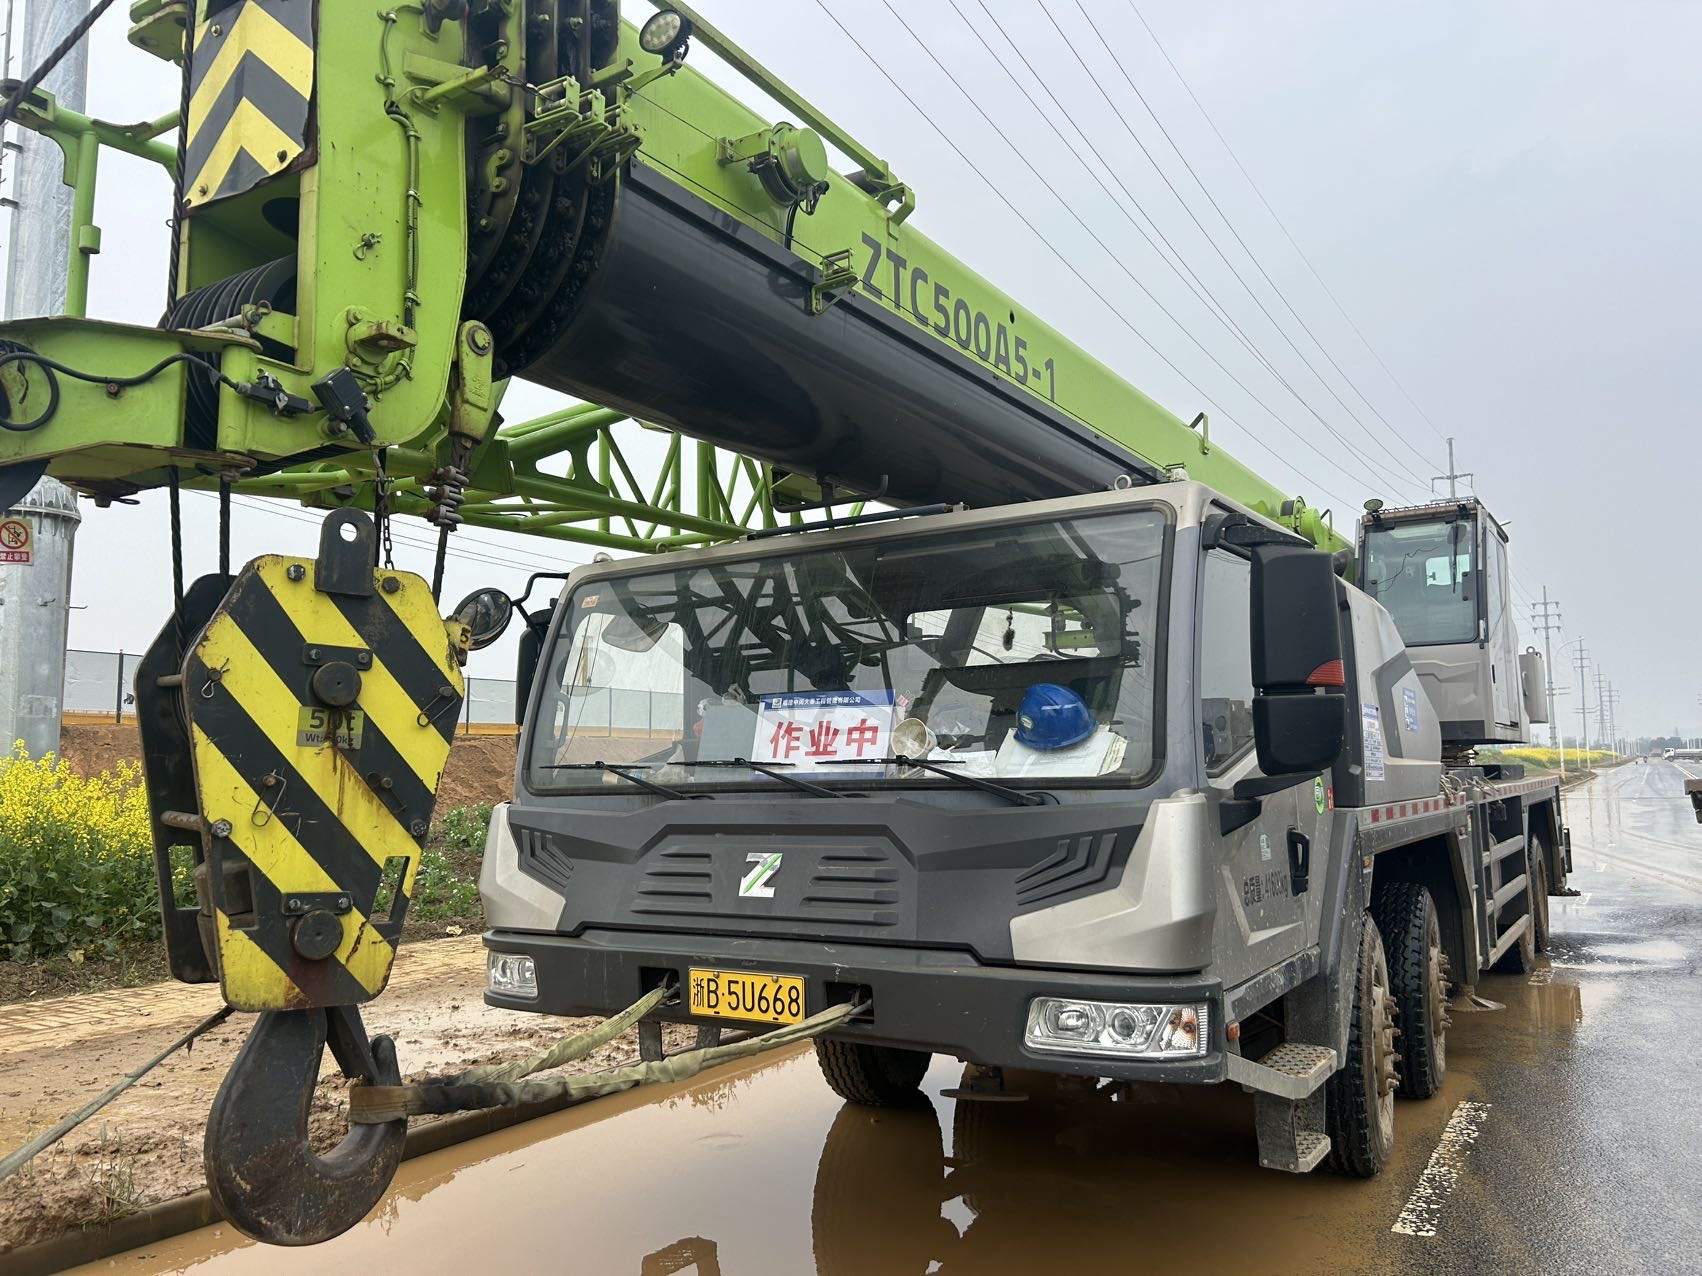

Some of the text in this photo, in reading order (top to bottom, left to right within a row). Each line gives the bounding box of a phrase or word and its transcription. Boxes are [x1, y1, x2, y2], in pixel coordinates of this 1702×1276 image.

[861, 231, 1055, 403] ZTC500A5-1
[770, 718, 879, 759] 作业中
